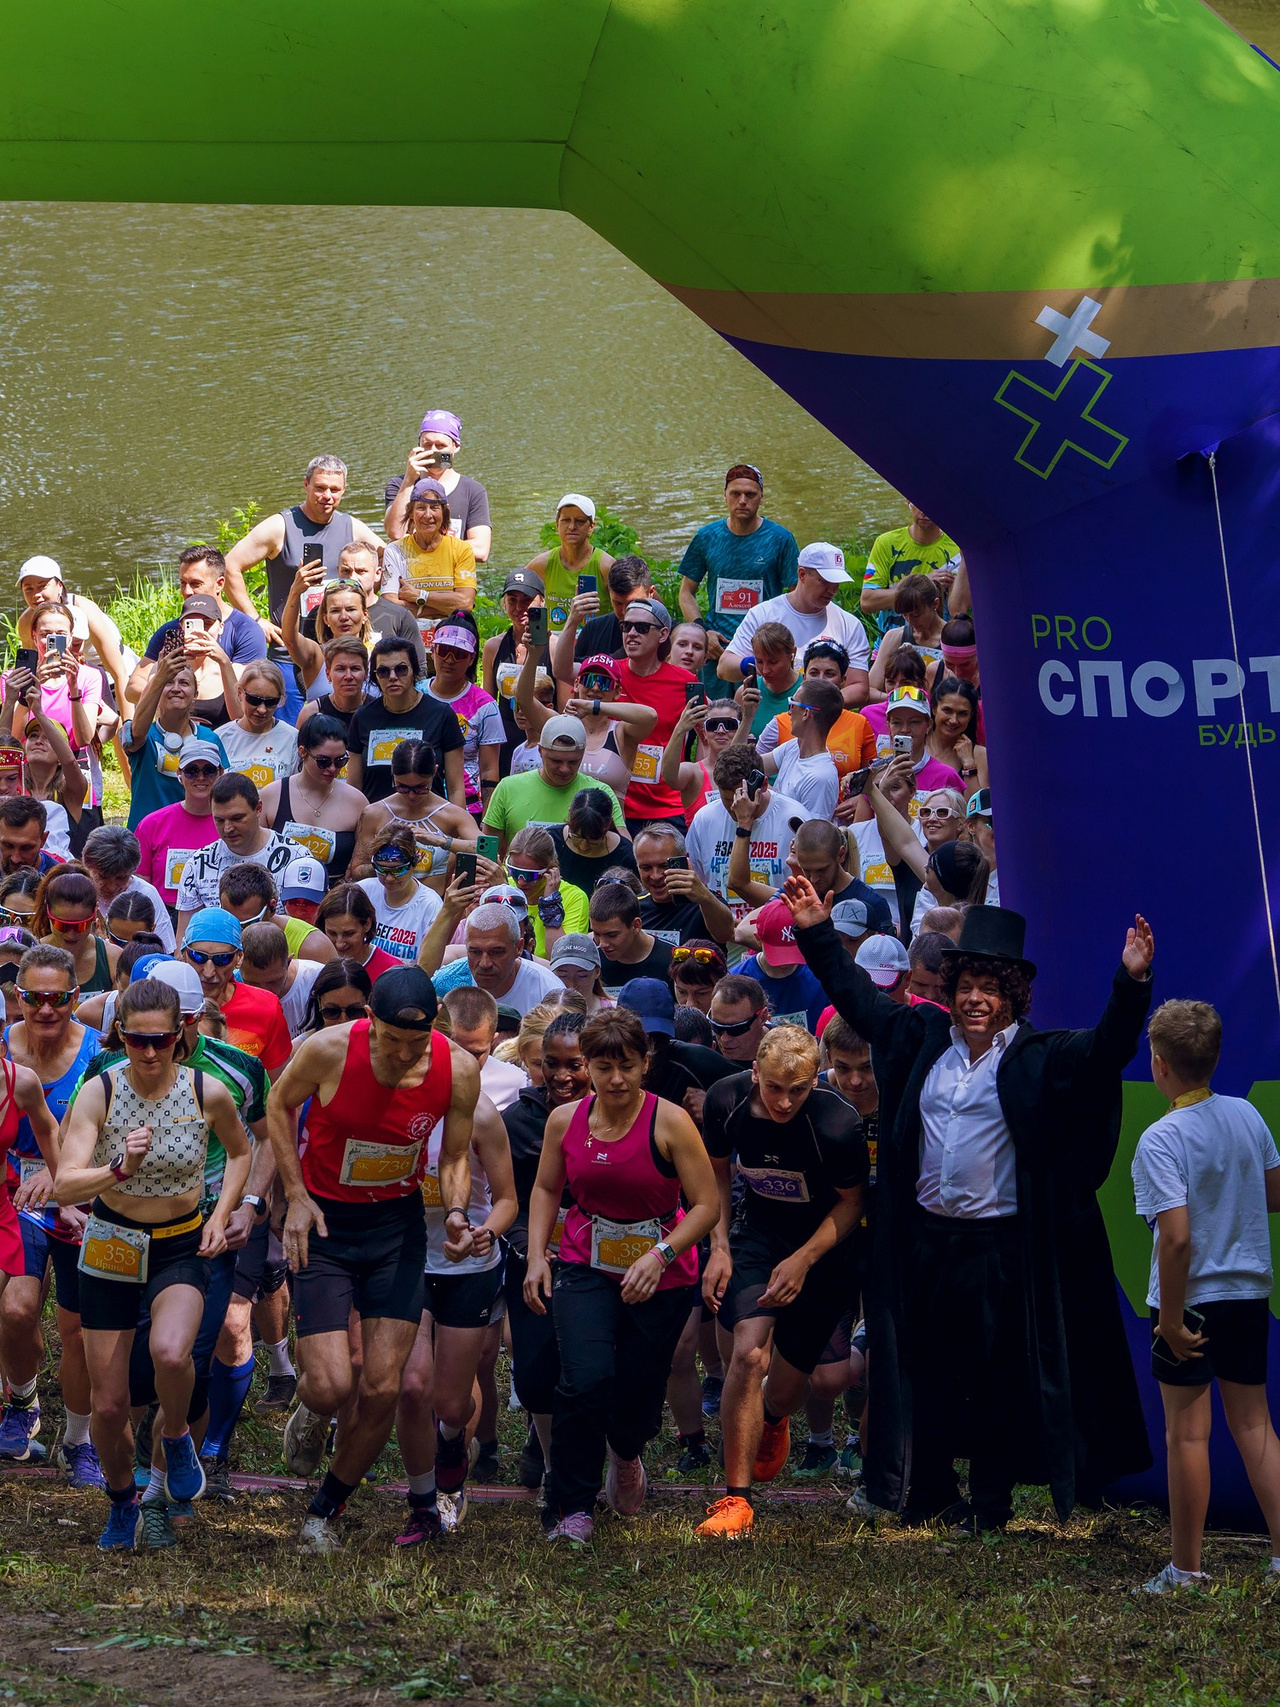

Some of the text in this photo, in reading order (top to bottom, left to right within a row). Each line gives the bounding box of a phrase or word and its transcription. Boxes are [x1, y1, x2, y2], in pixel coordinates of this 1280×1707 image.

[738, 592, 752, 604] 91
[1031, 614, 1112, 651] PRO
[587, 655, 614, 668] FCSM
[1037, 654, 1280, 718] СПОРТ
[1198, 722, 1278, 749] БУДЬ
[252, 769, 268, 782] 80
[781, 925, 796, 942] NY
[762, 1180, 796, 1192] 336
[103, 1244, 136, 1266] 353
[620, 1242, 653, 1259] 382
[95, 1258, 124, 1273] Ирина
